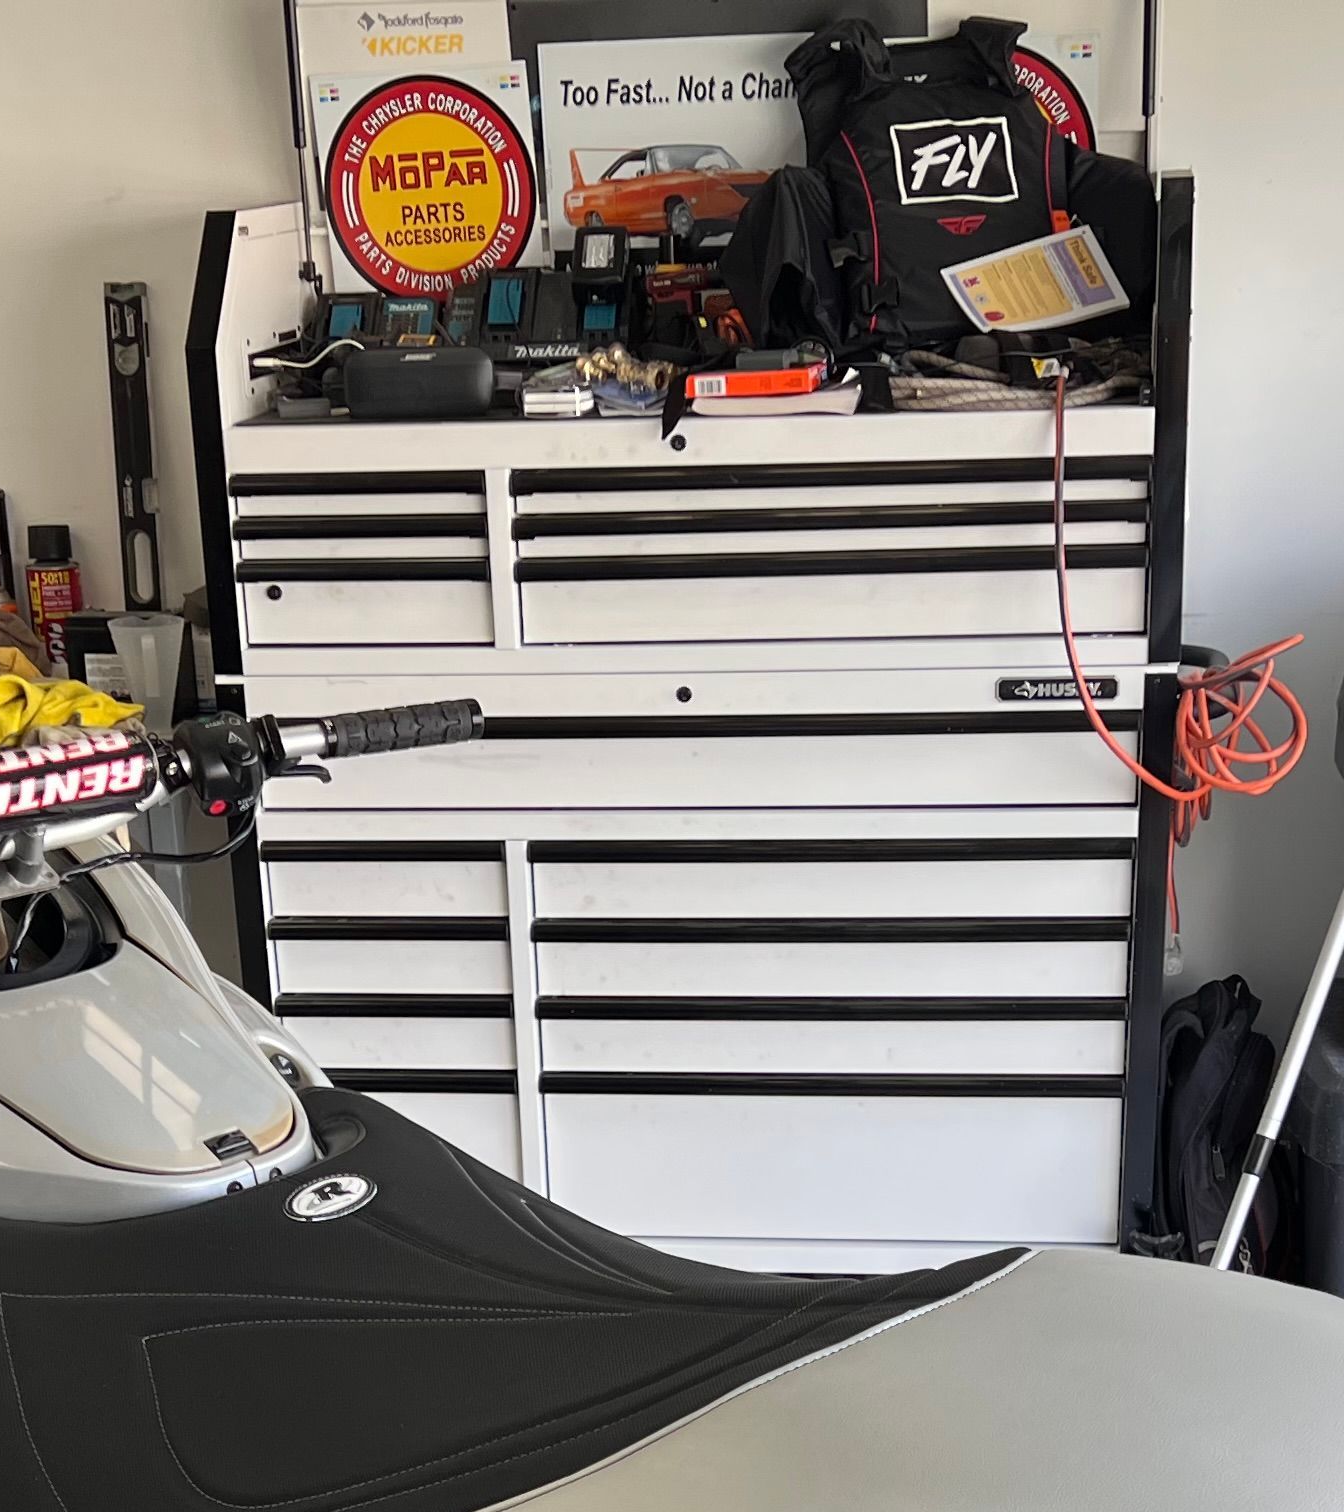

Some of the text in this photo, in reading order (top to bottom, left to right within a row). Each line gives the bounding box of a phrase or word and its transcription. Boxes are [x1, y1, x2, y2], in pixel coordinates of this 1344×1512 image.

[380, 33, 464, 56] KICKER
[560, 72, 796, 106] Too Fast... Not a Chan
[1015, 64, 1071, 125] PORATION
[344, 92, 507, 164] THE CHRYSLER CORPORATION
[910, 131, 998, 191] FLY
[401, 202, 465, 226] PARTS
[385, 225, 486, 247] ACCESSORIES
[355, 232, 393, 275] PARTS
[396, 269, 454, 293] DIVISION
[1037, 682, 1100, 697] HUSY
